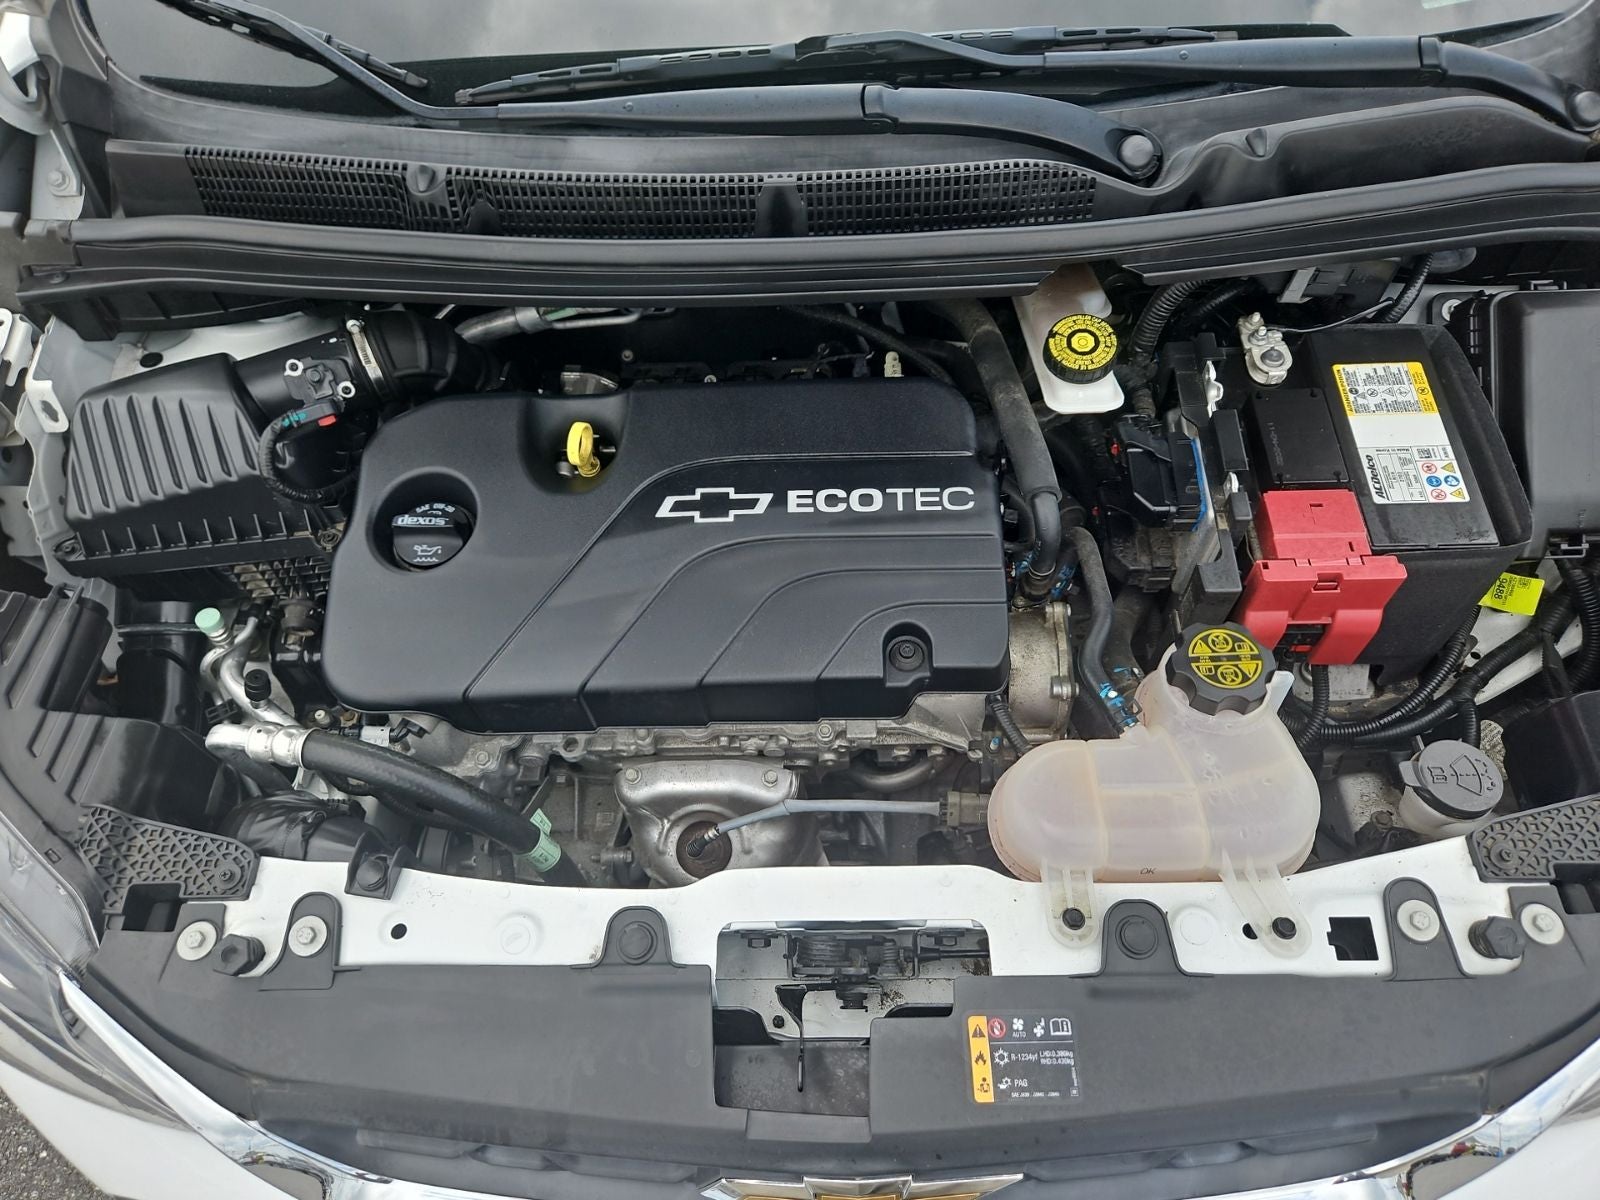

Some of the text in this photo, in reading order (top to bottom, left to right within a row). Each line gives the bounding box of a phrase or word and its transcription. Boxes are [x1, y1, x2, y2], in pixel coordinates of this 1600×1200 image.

[1365, 454, 1386, 499] ACDelco
[786, 486, 976, 513] ECOTEC
[397, 514, 449, 526] dexos
[1493, 577, 1508, 600] 9488
[1011, 1052, 1038, 1063] R-1234yf
[1014, 1079, 1028, 1088] PAG
